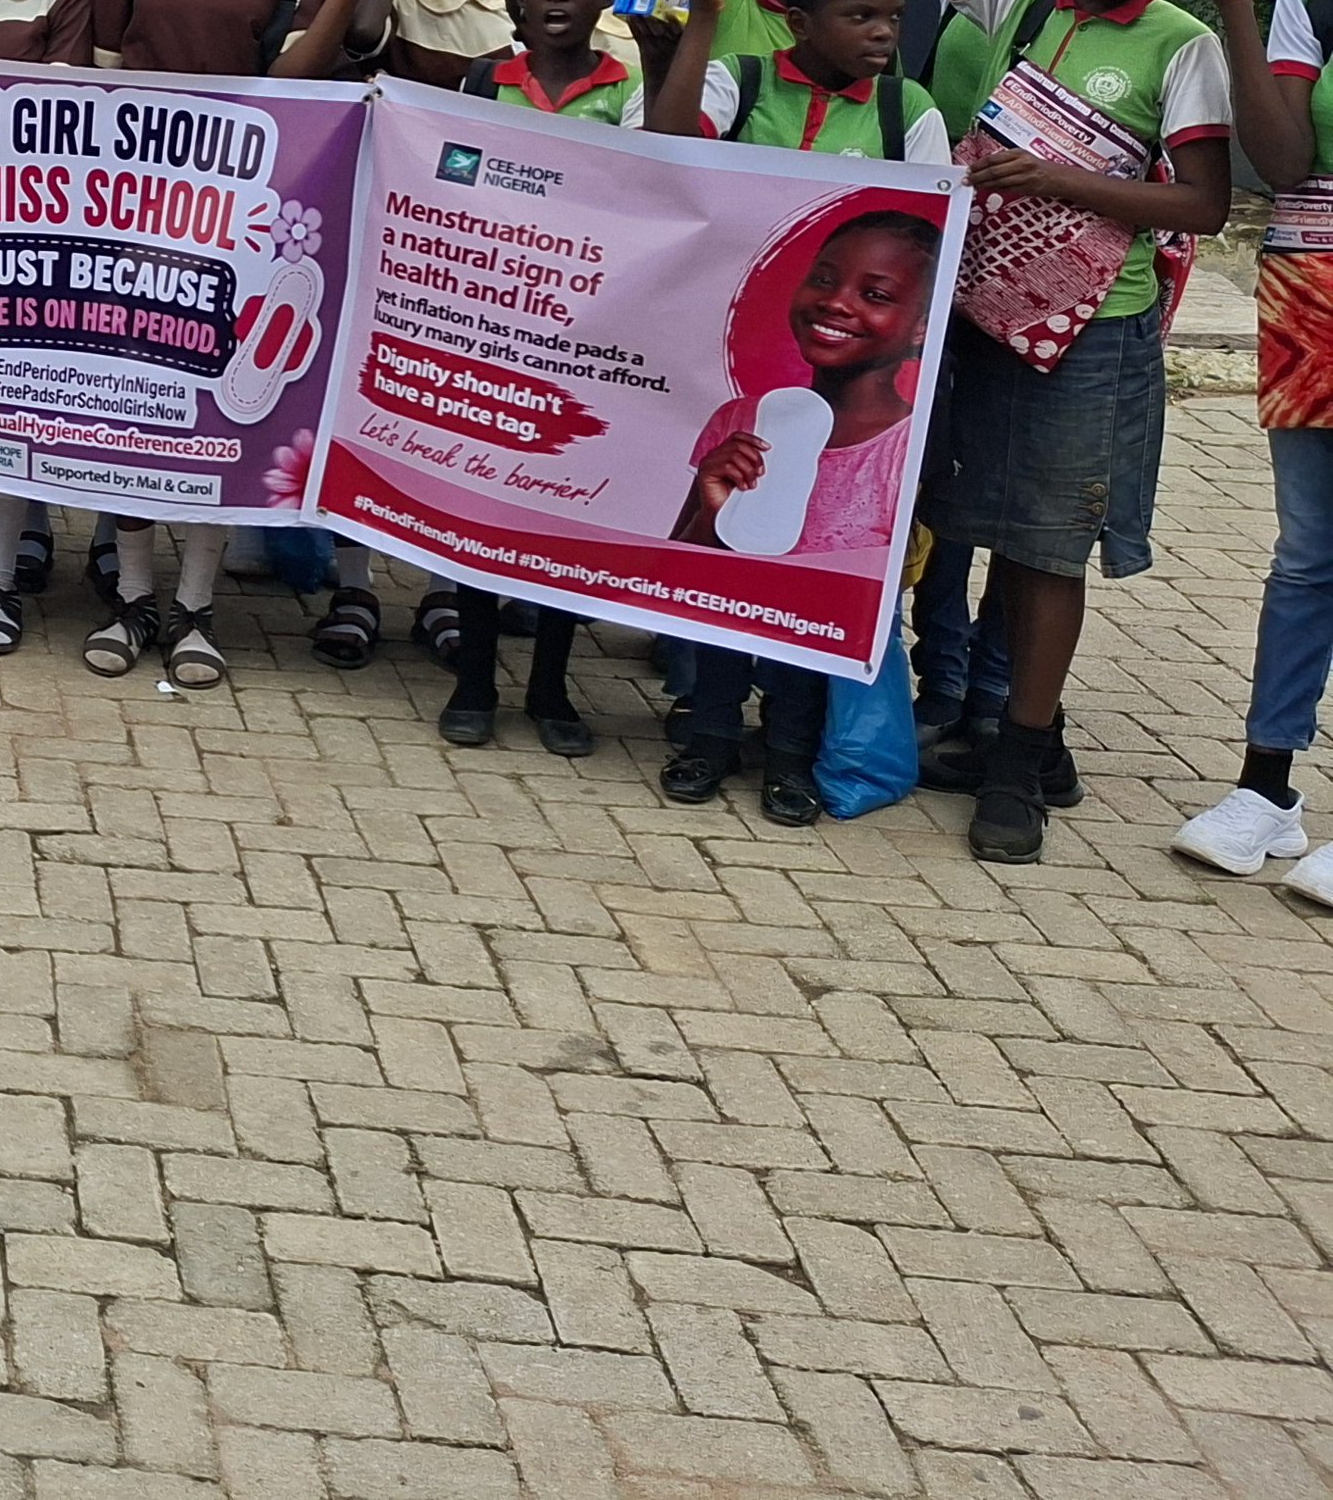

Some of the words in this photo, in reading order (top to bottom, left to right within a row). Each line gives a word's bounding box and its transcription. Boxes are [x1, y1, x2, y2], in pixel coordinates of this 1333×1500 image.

[12, 98, 101, 158] GIRL
[113, 102, 267, 182] SHOULD
[1003, 78, 1093, 144] #EndPeriodPoverty
[483, 171, 547, 198] NIGERIA
[486, 156, 565, 186] CEE-HOPE
[83, 167, 237, 252] SCHOOL
[385, 190, 576, 259] Menstruation
[580, 235, 605, 265] is
[69, 252, 221, 313] BECAUSE
[379, 249, 460, 296] health
[463, 275, 520, 311] and
[523, 288, 576, 329] life,
[382, 226, 396, 246] a
[400, 226, 500, 273] natural
[502, 253, 564, 289] sign
[569, 271, 606, 297] of
[16, 297, 38, 327] IS
[44, 298, 76, 330] ON
[82, 301, 129, 338] HER
[133, 307, 222, 358] PERIOD.
[374, 304, 424, 339] luxury
[425, 324, 478, 354] many
[479, 338, 521, 365] girls
[522, 351, 597, 381] cannot
[598, 368, 672, 395] afford.
[375, 287, 400, 307] yet
[399, 292, 475, 330] inflation
[478, 313, 512, 339] has
[513, 327, 573, 354] made
[574, 339, 629, 364] pads
[630, 352, 645, 367] a
[374, 369, 419, 404] have
[421, 392, 435, 409] a
[436, 394, 494, 427] price
[495, 410, 543, 443] tag.
[376, 342, 452, 389] Dignity
[452, 371, 565, 416] shouldn't
[40, 461, 112, 485] Supported
[113, 469, 135, 488] by:
[136, 471, 162, 492] Mal
[163, 478, 177, 492] &
[177, 480, 214, 496] Carol
[358, 411, 400, 449] Let's
[402, 429, 465, 470] break
[463, 453, 499, 482] the
[503, 462, 611, 507] barrier!
[354, 495, 517, 566] #PeriodFriendlyWorld
[518, 551, 671, 601] #DignityForGirls
[671, 586, 847, 643] #CEEHOPENigeria
